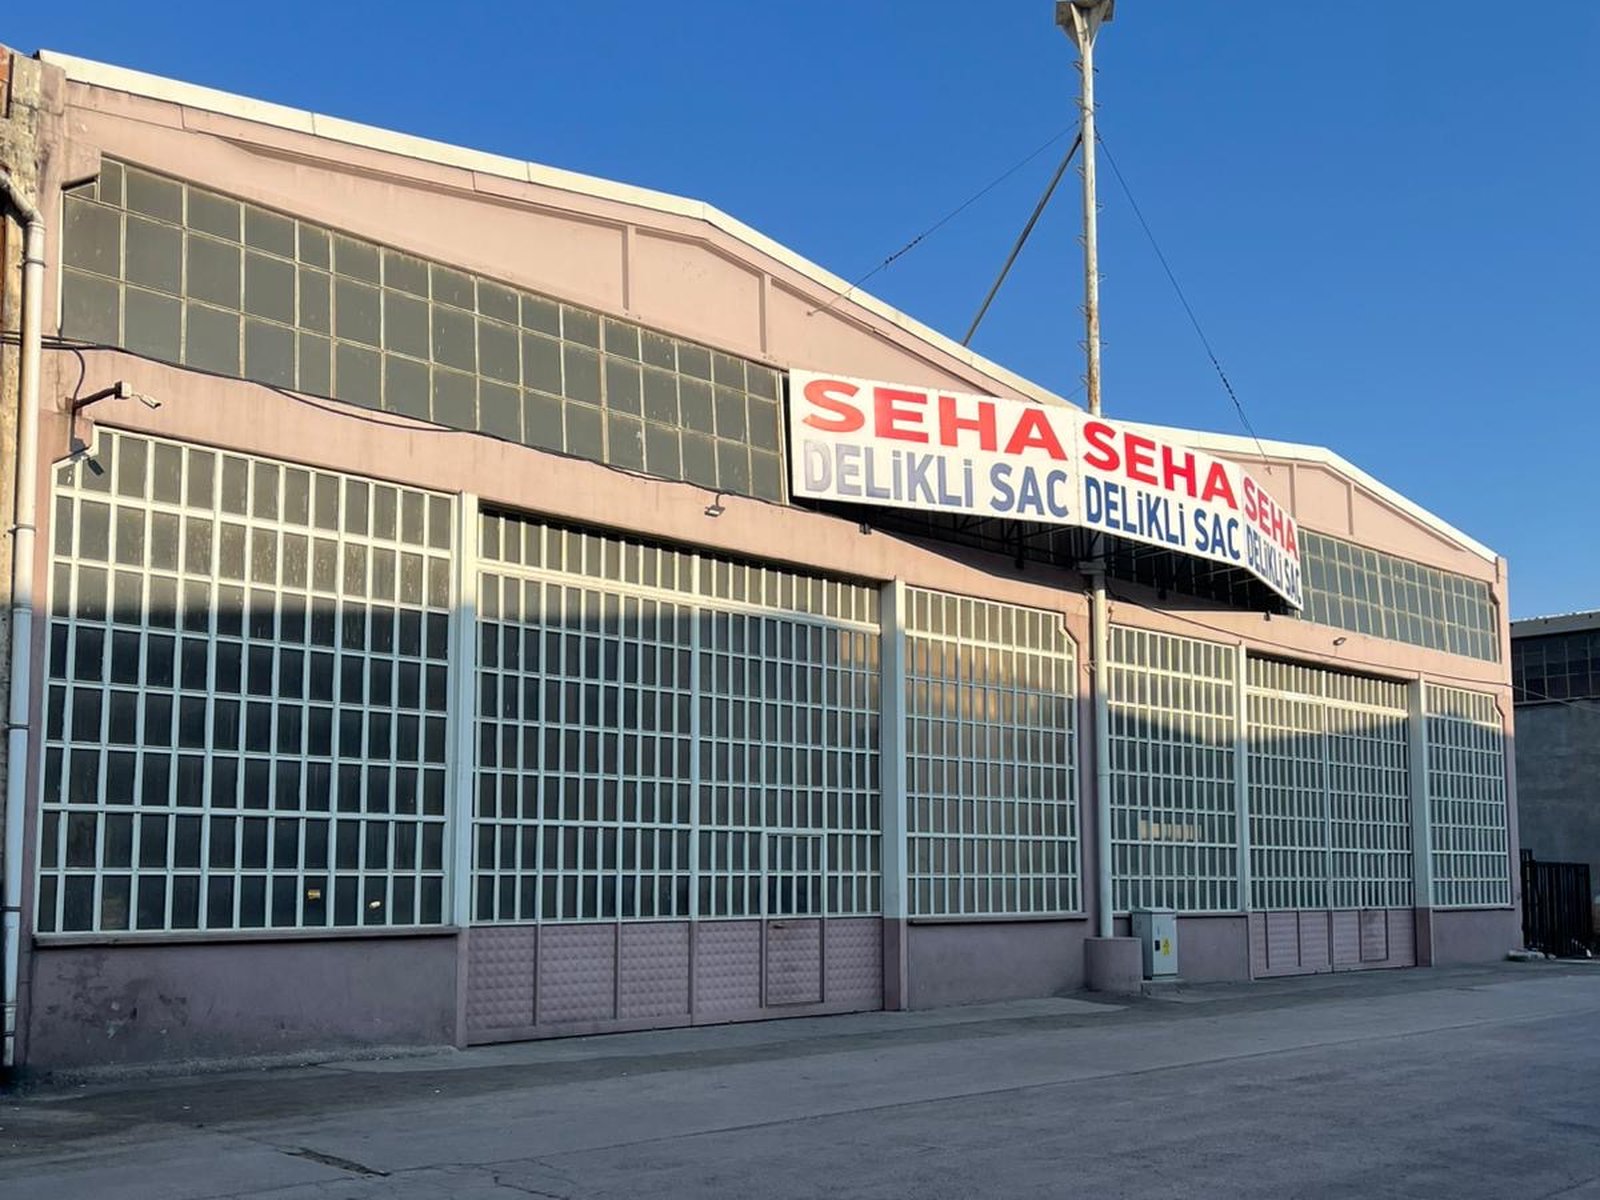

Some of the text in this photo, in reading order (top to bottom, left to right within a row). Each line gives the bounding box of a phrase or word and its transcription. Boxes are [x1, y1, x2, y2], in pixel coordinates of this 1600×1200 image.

[802, 379, 1068, 461] SEHA
[989, 463, 1069, 518] SAC
[1083, 421, 1239, 510] SEHA
[1193, 508, 1241, 560] SAC
[1243, 476, 1298, 561] SEHA
[1285, 556, 1302, 605] SAC
